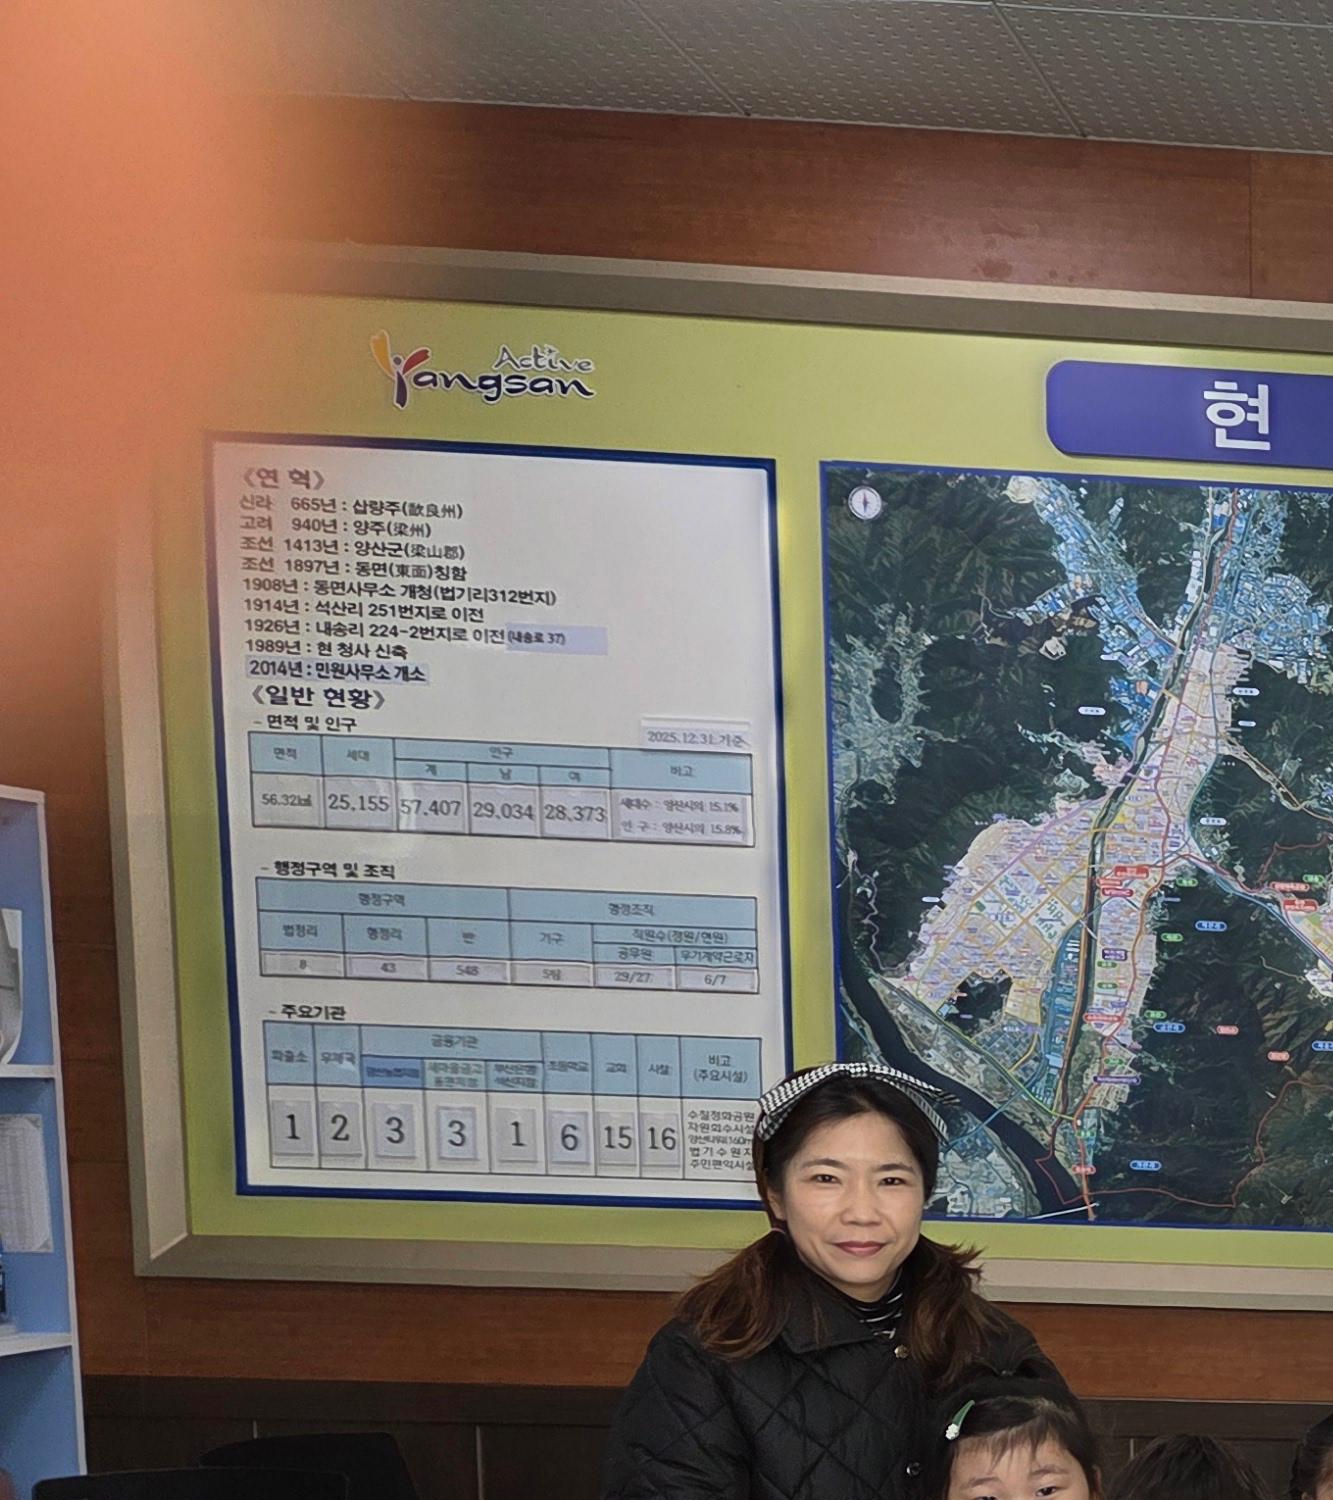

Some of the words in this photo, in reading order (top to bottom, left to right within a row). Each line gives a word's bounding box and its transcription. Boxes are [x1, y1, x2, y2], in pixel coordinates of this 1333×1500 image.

[495, 344, 594, 374] Active
[1203, 380, 1271, 452] 현
[290, 497, 337, 514] 665년
[240, 515, 273, 531] 고려
[291, 517, 338, 534] 940년
[240, 535, 274, 553] 조선
[284, 538, 339, 555] 1413년
[241, 556, 275, 573] 조선
[284, 559, 340, 576] 1897년
[242, 577, 299, 594] 1908년
[313, 580, 397, 598] 동면사무소
[244, 598, 299, 615] 1914년
[315, 600, 364, 618] 석산리
[368, 604, 448, 621] 251번지로
[451, 606, 485, 623] 이전
[244, 618, 300, 635] 1926년
[316, 621, 364, 638] 내송리
[368, 623, 469, 642] 224-2번지로
[473, 628, 505, 645] 이전
[245, 638, 301, 655] 1989년
[316, 641, 332, 657] 현
[337, 642, 370, 658] 청사
[375, 643, 408, 660] 신축
[250, 659, 303, 678] 2014년
[315, 661, 392, 681] 민원사무소
[394, 665, 427, 683] 개소
[267, 714, 299, 731] 면적
[304, 715, 320, 732] 및
[324, 716, 358, 733] 인구
[274, 859, 338, 878] 행정구역
[343, 862, 359, 878] 및
[363, 863, 397, 880] 조직
[704, 973, 727, 987] 6/7
[281, 1003, 347, 1021] 주요기관
[285, 1113, 301, 1141] 1
[330, 1113, 350, 1142] 2
[385, 1116, 405, 1144] 3
[447, 1119, 467, 1148] 3
[510, 1120, 528, 1147] 1
[560, 1123, 579, 1151] 6
[604, 1125, 633, 1150] 15
[647, 1126, 677, 1151] 16
